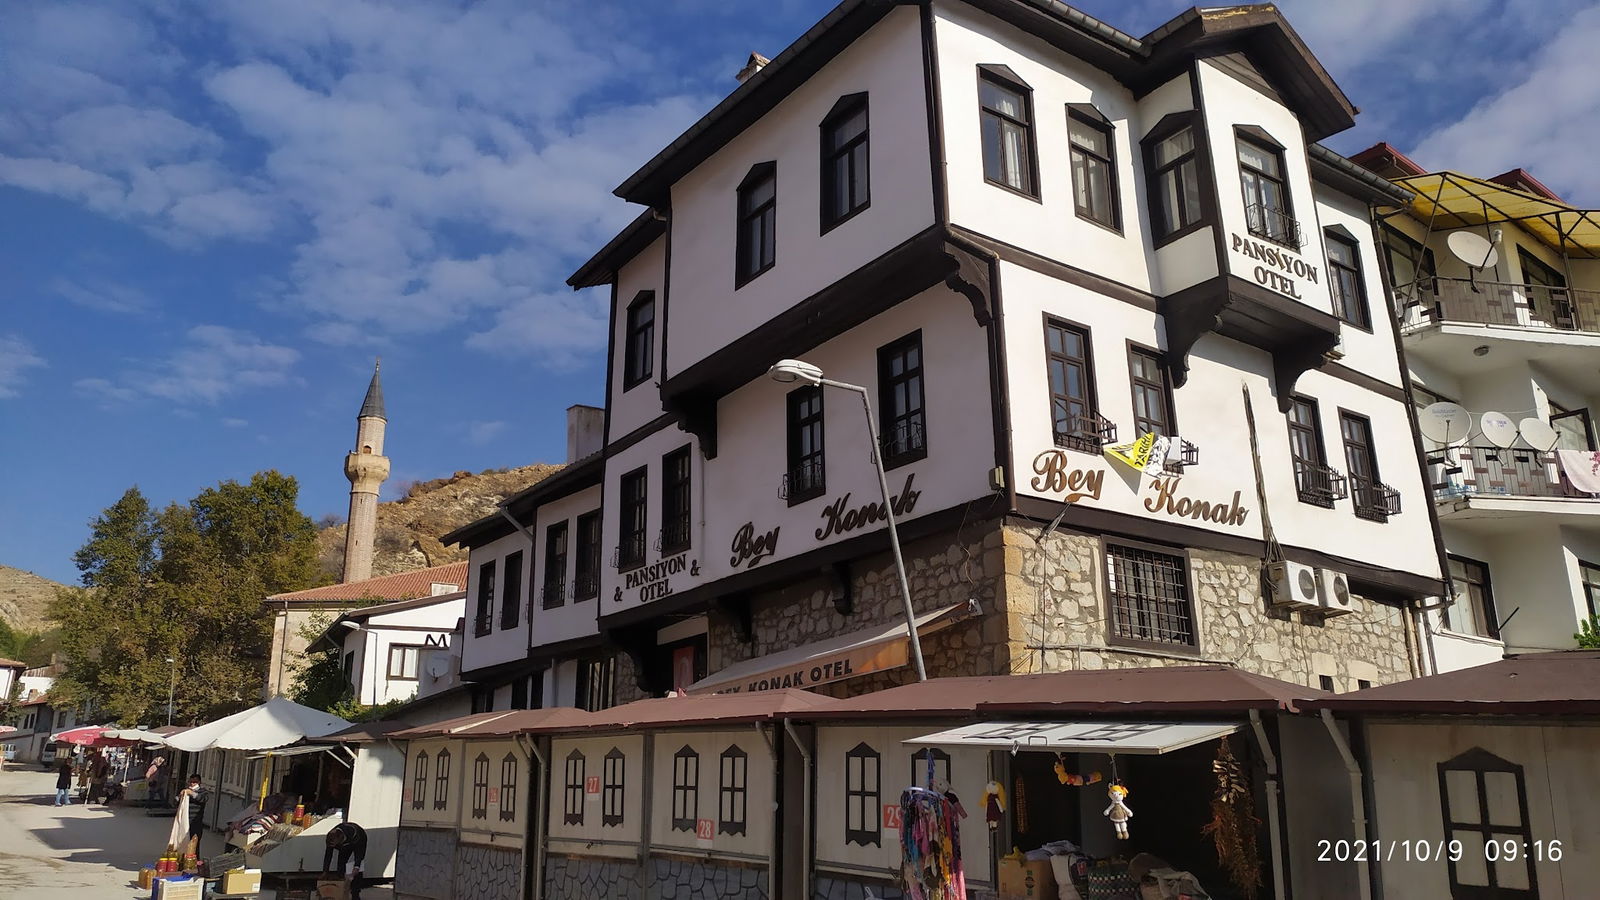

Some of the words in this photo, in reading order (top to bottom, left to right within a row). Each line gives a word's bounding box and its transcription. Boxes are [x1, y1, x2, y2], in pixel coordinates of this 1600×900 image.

[1231, 232, 1319, 285] PANSİYON
[1254, 265, 1303, 300] OTEL
[1030, 449, 1105, 504] Bey
[1144, 476, 1250, 526] Konak
[729, 521, 780, 569] Bey
[815, 472, 922, 541] Konak
[625, 553, 687, 589] PANSİYON
[639, 578, 673, 602] OTEL
[748, 670, 804, 692] KONAK
[810, 658, 853, 682] OTEL
[588, 777, 598, 793] 27
[699, 820, 711, 838] 28
